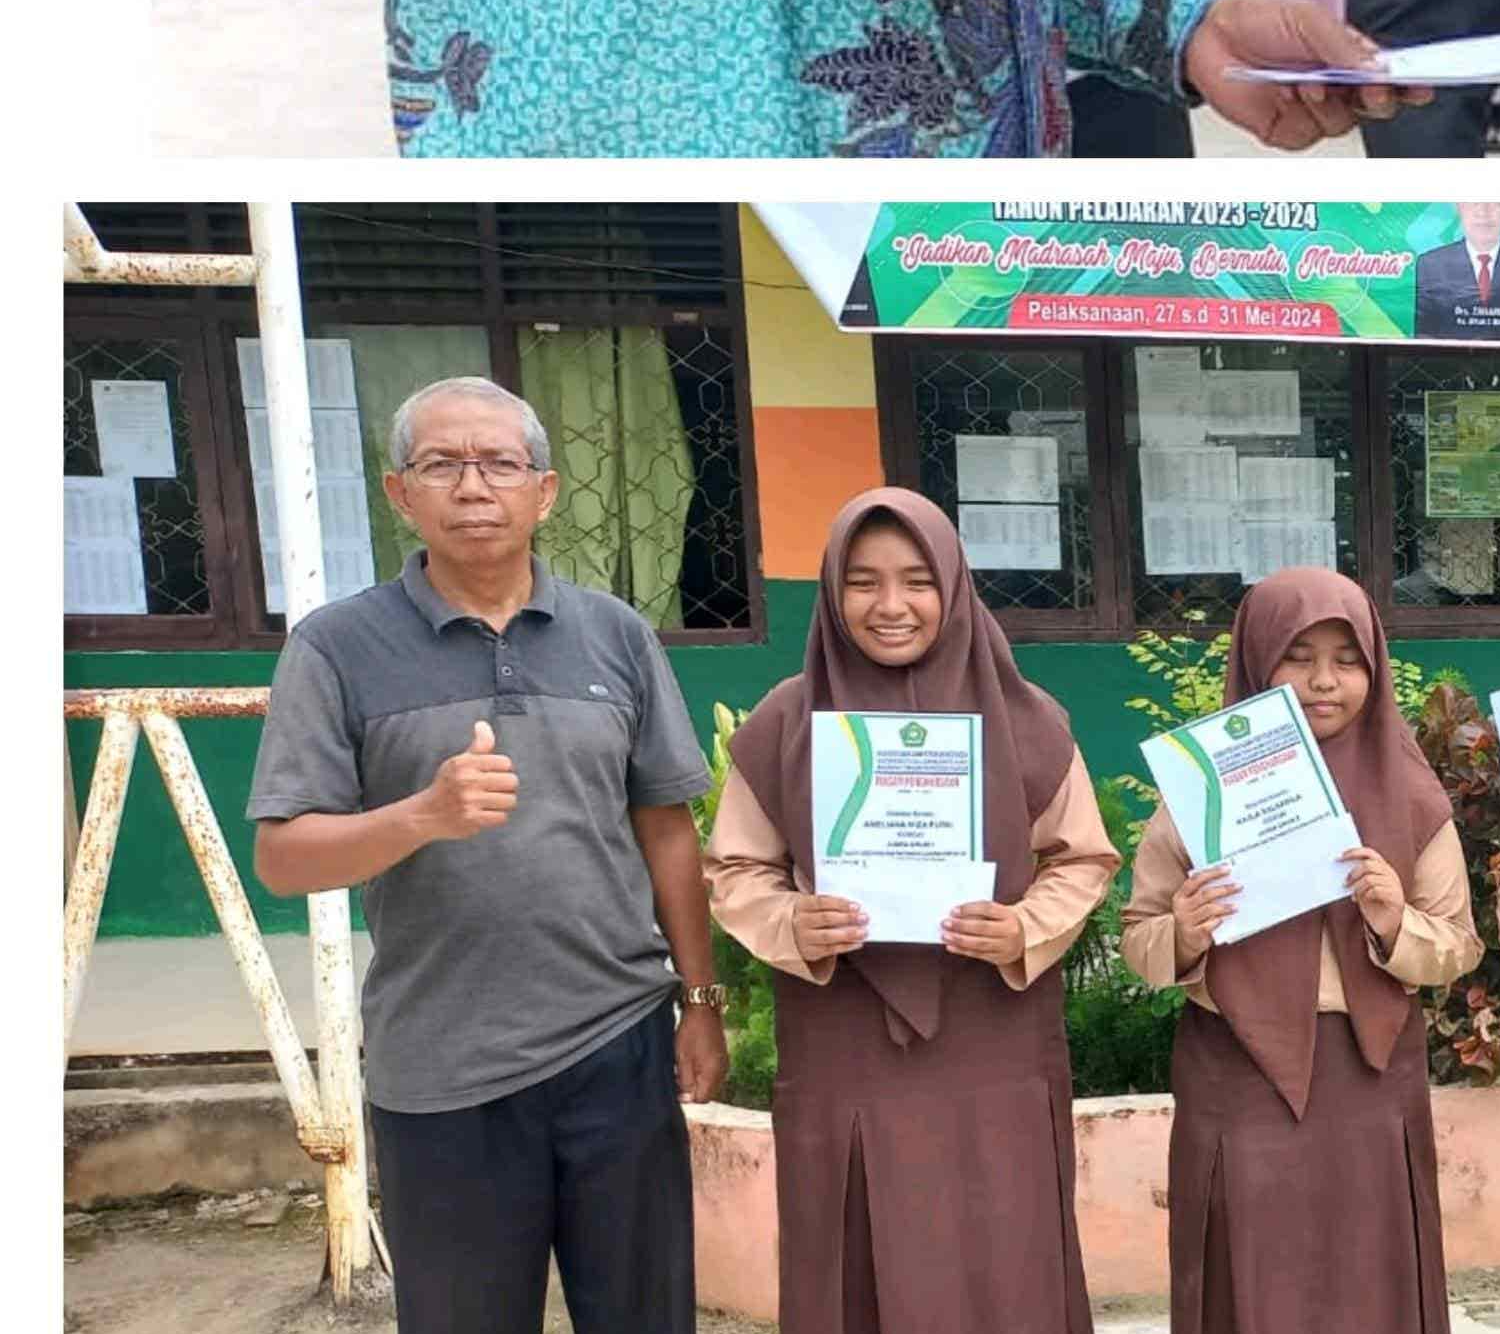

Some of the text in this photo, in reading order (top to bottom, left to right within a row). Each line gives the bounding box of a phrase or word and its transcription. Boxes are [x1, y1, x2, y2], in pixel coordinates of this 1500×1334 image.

[1261, 203, 1318, 229] 2024
[998, 237, 1110, 272] Madrasah
[1028, 300, 1150, 324] Pelaksanaan,
[1155, 304, 1174, 324] 27
[1219, 305, 1239, 325] 31
[1245, 306, 1276, 326] Mei
[1281, 307, 1321, 328] 2024
